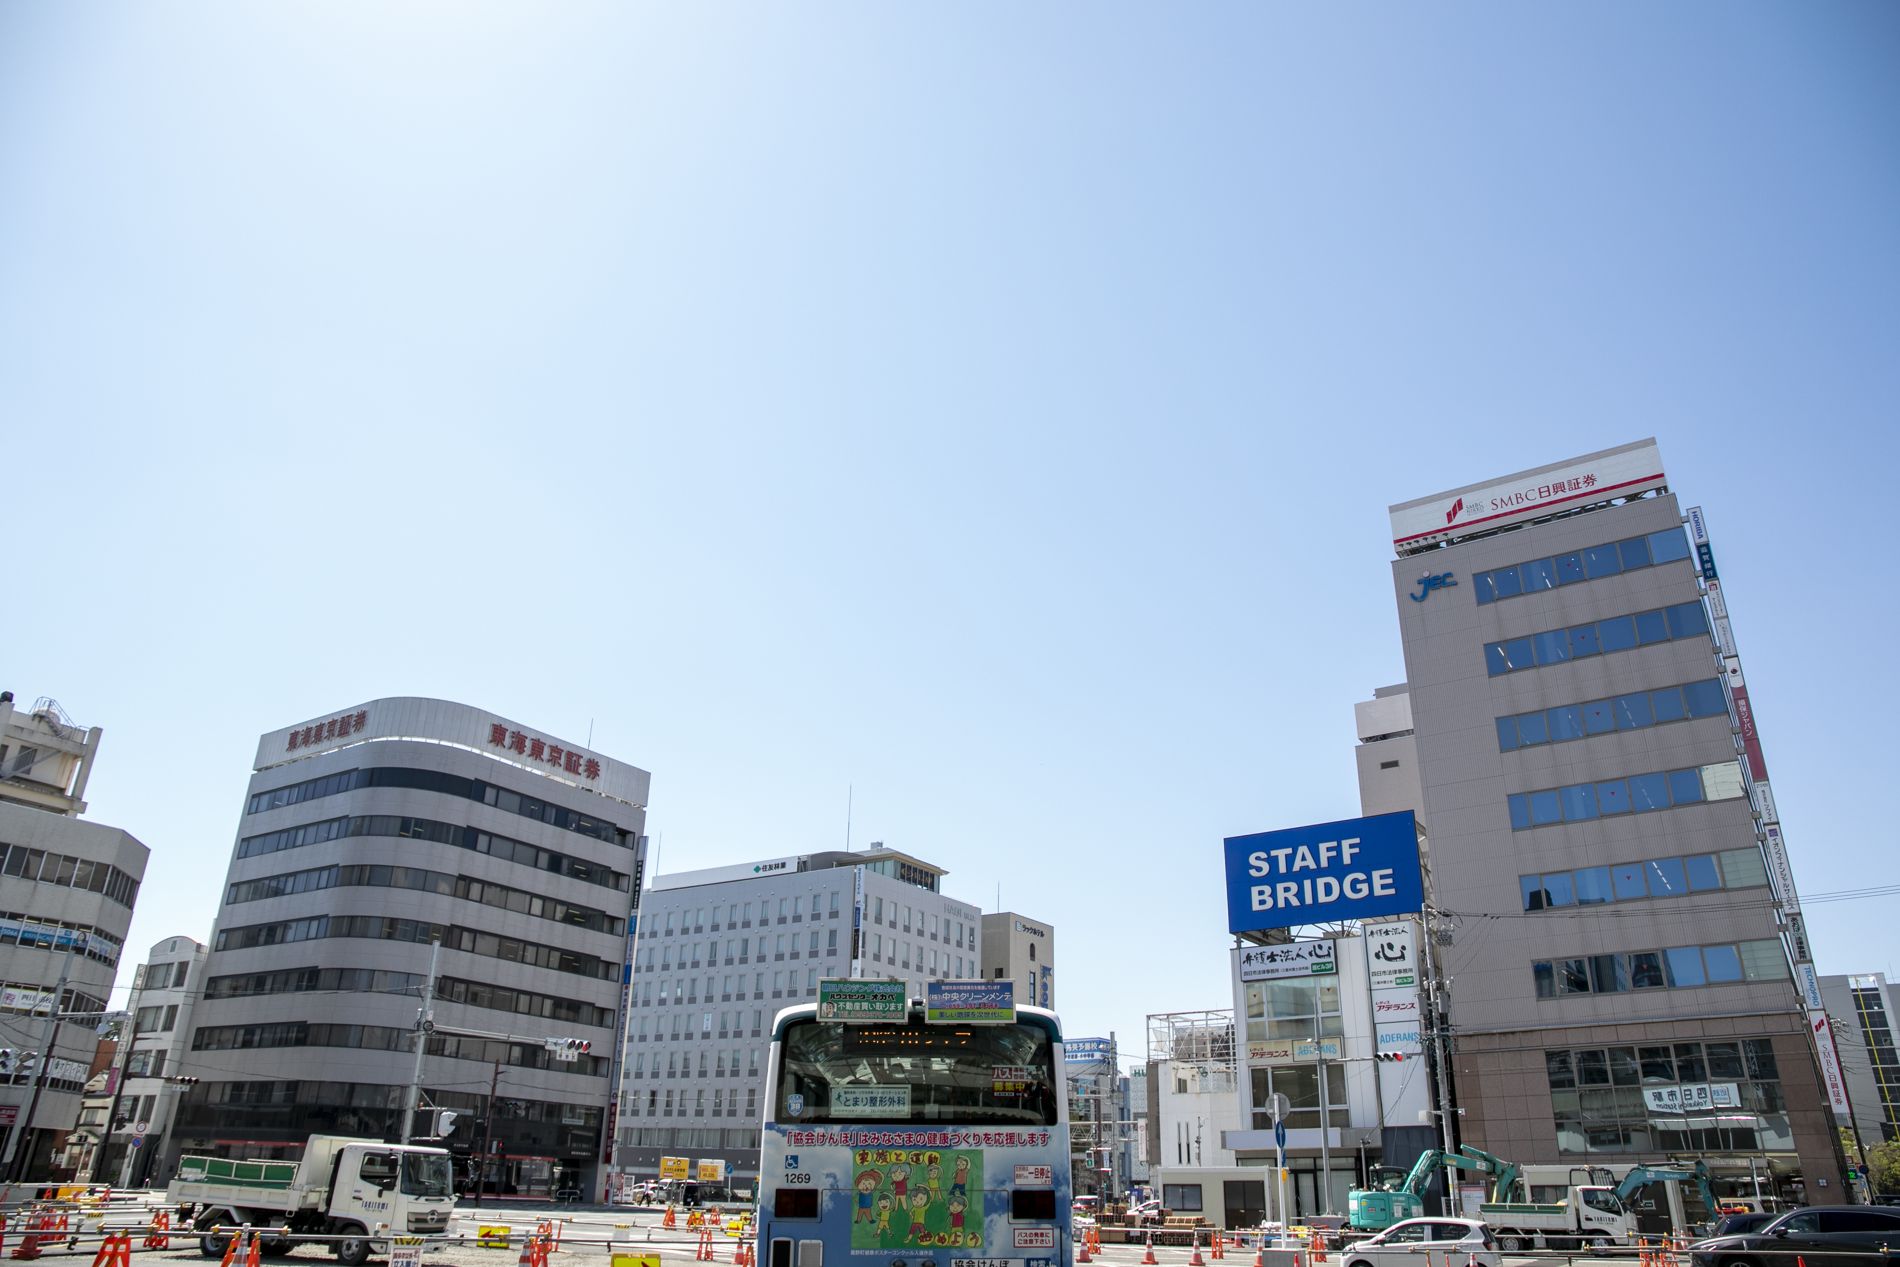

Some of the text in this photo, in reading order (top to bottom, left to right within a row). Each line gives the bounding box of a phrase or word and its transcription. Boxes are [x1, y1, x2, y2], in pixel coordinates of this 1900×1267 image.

[1491, 474, 1597, 510] SMBC日興証券
[1692, 511, 1704, 540] HORIBA
[1738, 698, 1752, 736] 損保ジャパン
[286, 709, 368, 753] 東海東京証券
[489, 722, 602, 780] 東海東京証券
[1248, 837, 1361, 878] STAFF
[762, 861, 786, 872] 住友林業
[1250, 868, 1397, 912] BRIDGE
[1374, 942, 1407, 962] 心
[1243, 967, 1279, 977] 四日市法律事務所
[1371, 968, 1413, 977] 四日市法律事務所
[1803, 965, 1819, 1006] TECHNOPRO
[838, 1002, 904, 1011] 不動産買い取ります
[1377, 1003, 1416, 1012] アデランス
[1380, 1032, 1419, 1047] ADERANS
[1250, 1051, 1289, 1060] アデランス
[993, 1067, 1012, 1079] バス
[1822, 1044, 1842, 1105] SMBC日興証券
[994, 1081, 1025, 1091] 募集中
[844, 1096, 906, 1108] とまり整形外科
[786, 1130, 1050, 1149] 「協会けんぽ」はみなさまの健康づくりを応援します
[857, 1151, 941, 1165] 家族と運動
[785, 1173, 811, 1184] 1269
